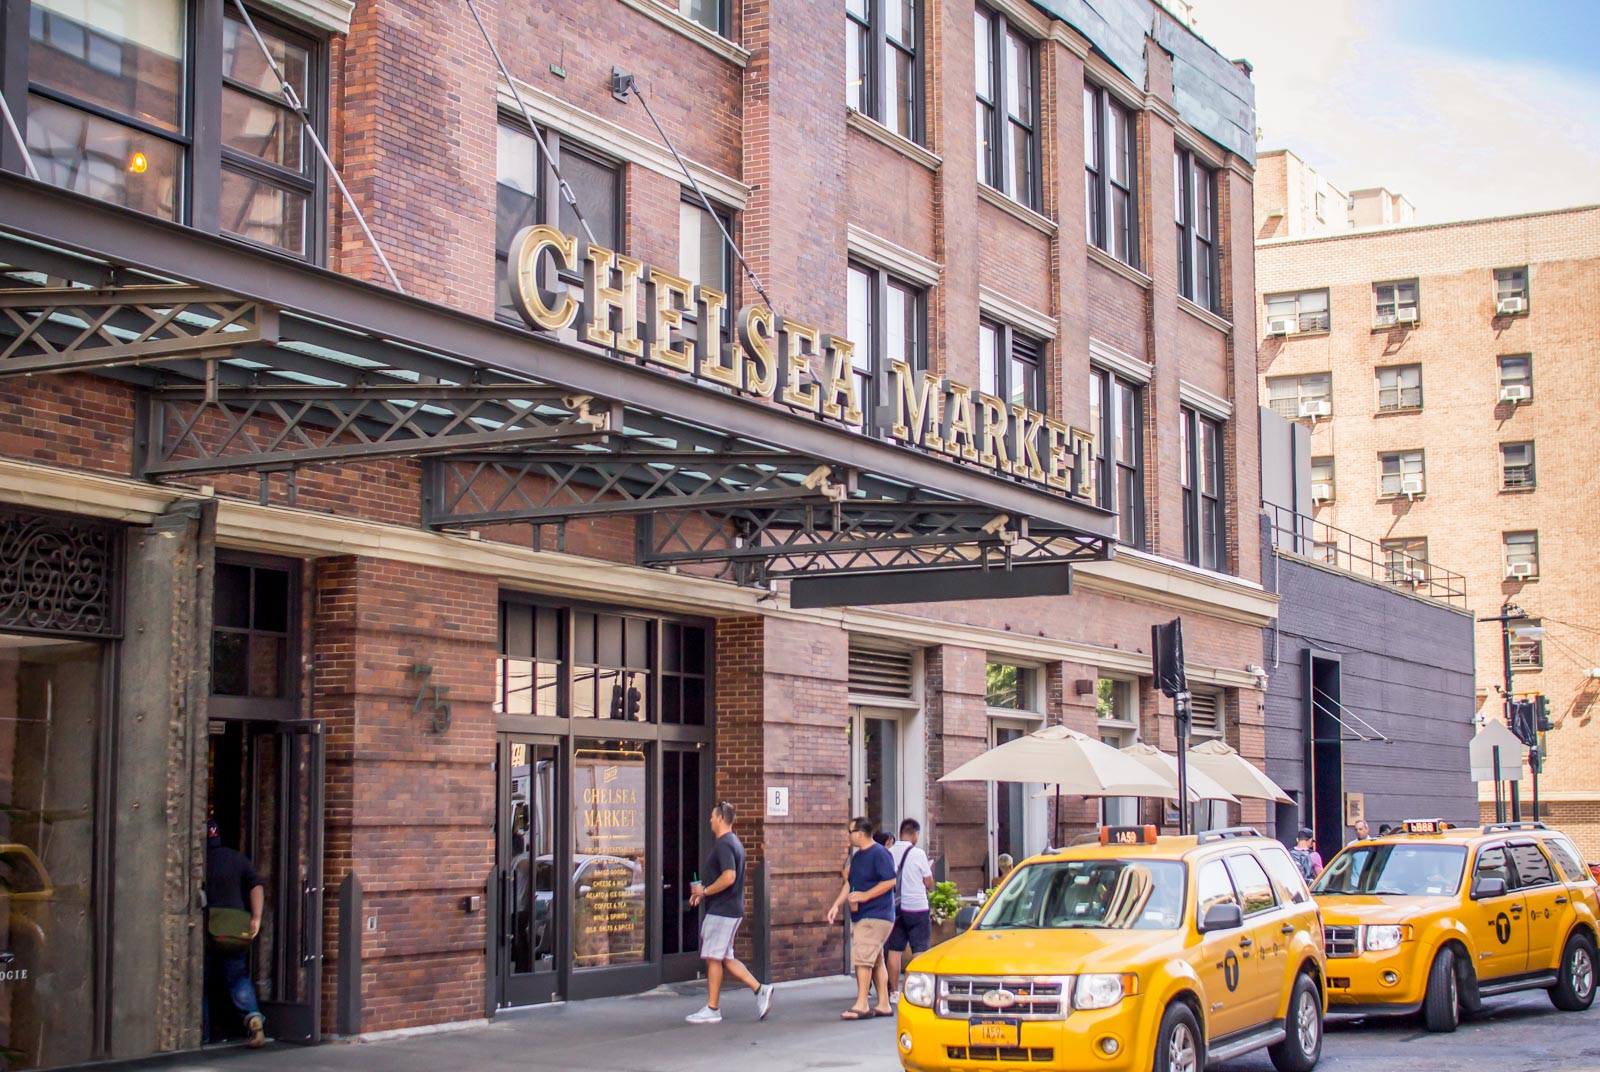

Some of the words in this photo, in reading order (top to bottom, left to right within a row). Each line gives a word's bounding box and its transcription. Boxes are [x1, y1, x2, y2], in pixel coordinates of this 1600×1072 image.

[508, 224, 863, 427] CHELSEA
[878, 358, 1096, 499] MARKET
[410, 663, 452, 735] 75
[583, 788, 636, 804] CHELSEA
[775, 790, 781, 806] B
[583, 809, 637, 827] MARKET
[1115, 831, 1137, 844] 1A59
